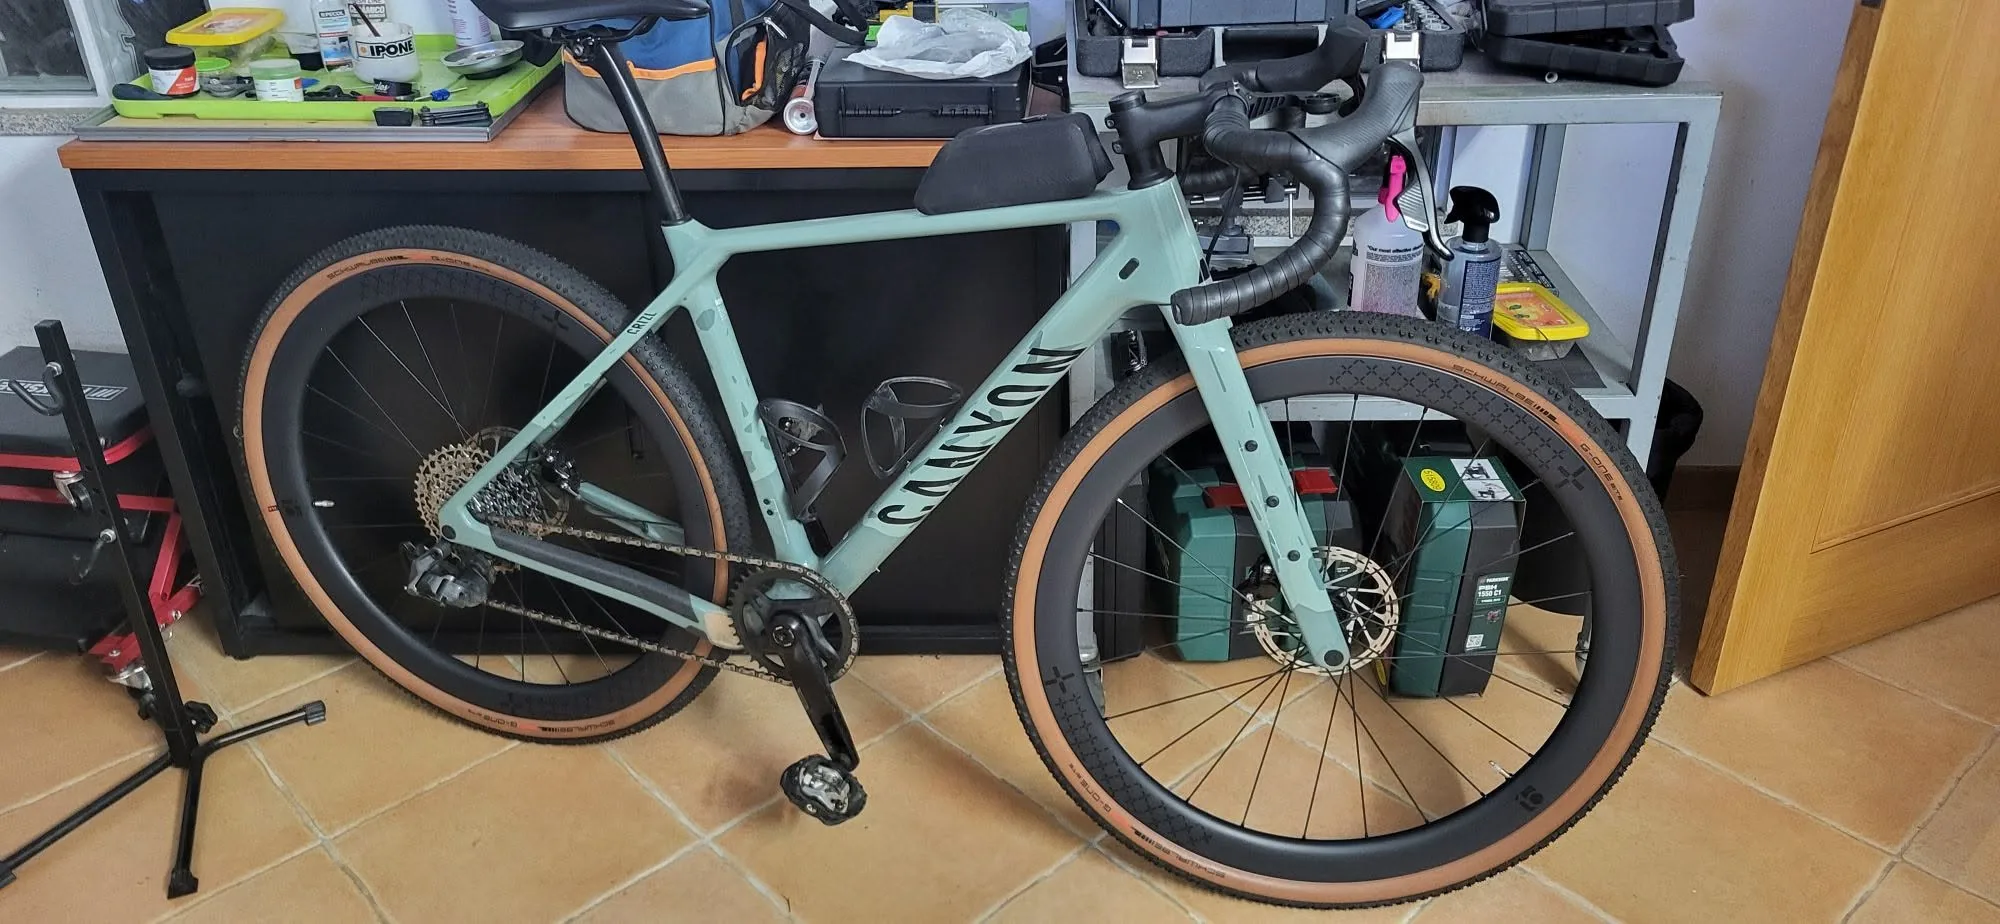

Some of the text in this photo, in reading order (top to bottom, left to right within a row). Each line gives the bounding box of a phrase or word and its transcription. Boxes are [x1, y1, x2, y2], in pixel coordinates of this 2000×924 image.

[370, 40, 414, 57] IPONE
[877, 347, 1088, 525] CANYON
[1452, 364, 1535, 407] SCHWALBE
[1580, 442, 1615, 482] G-ONE
